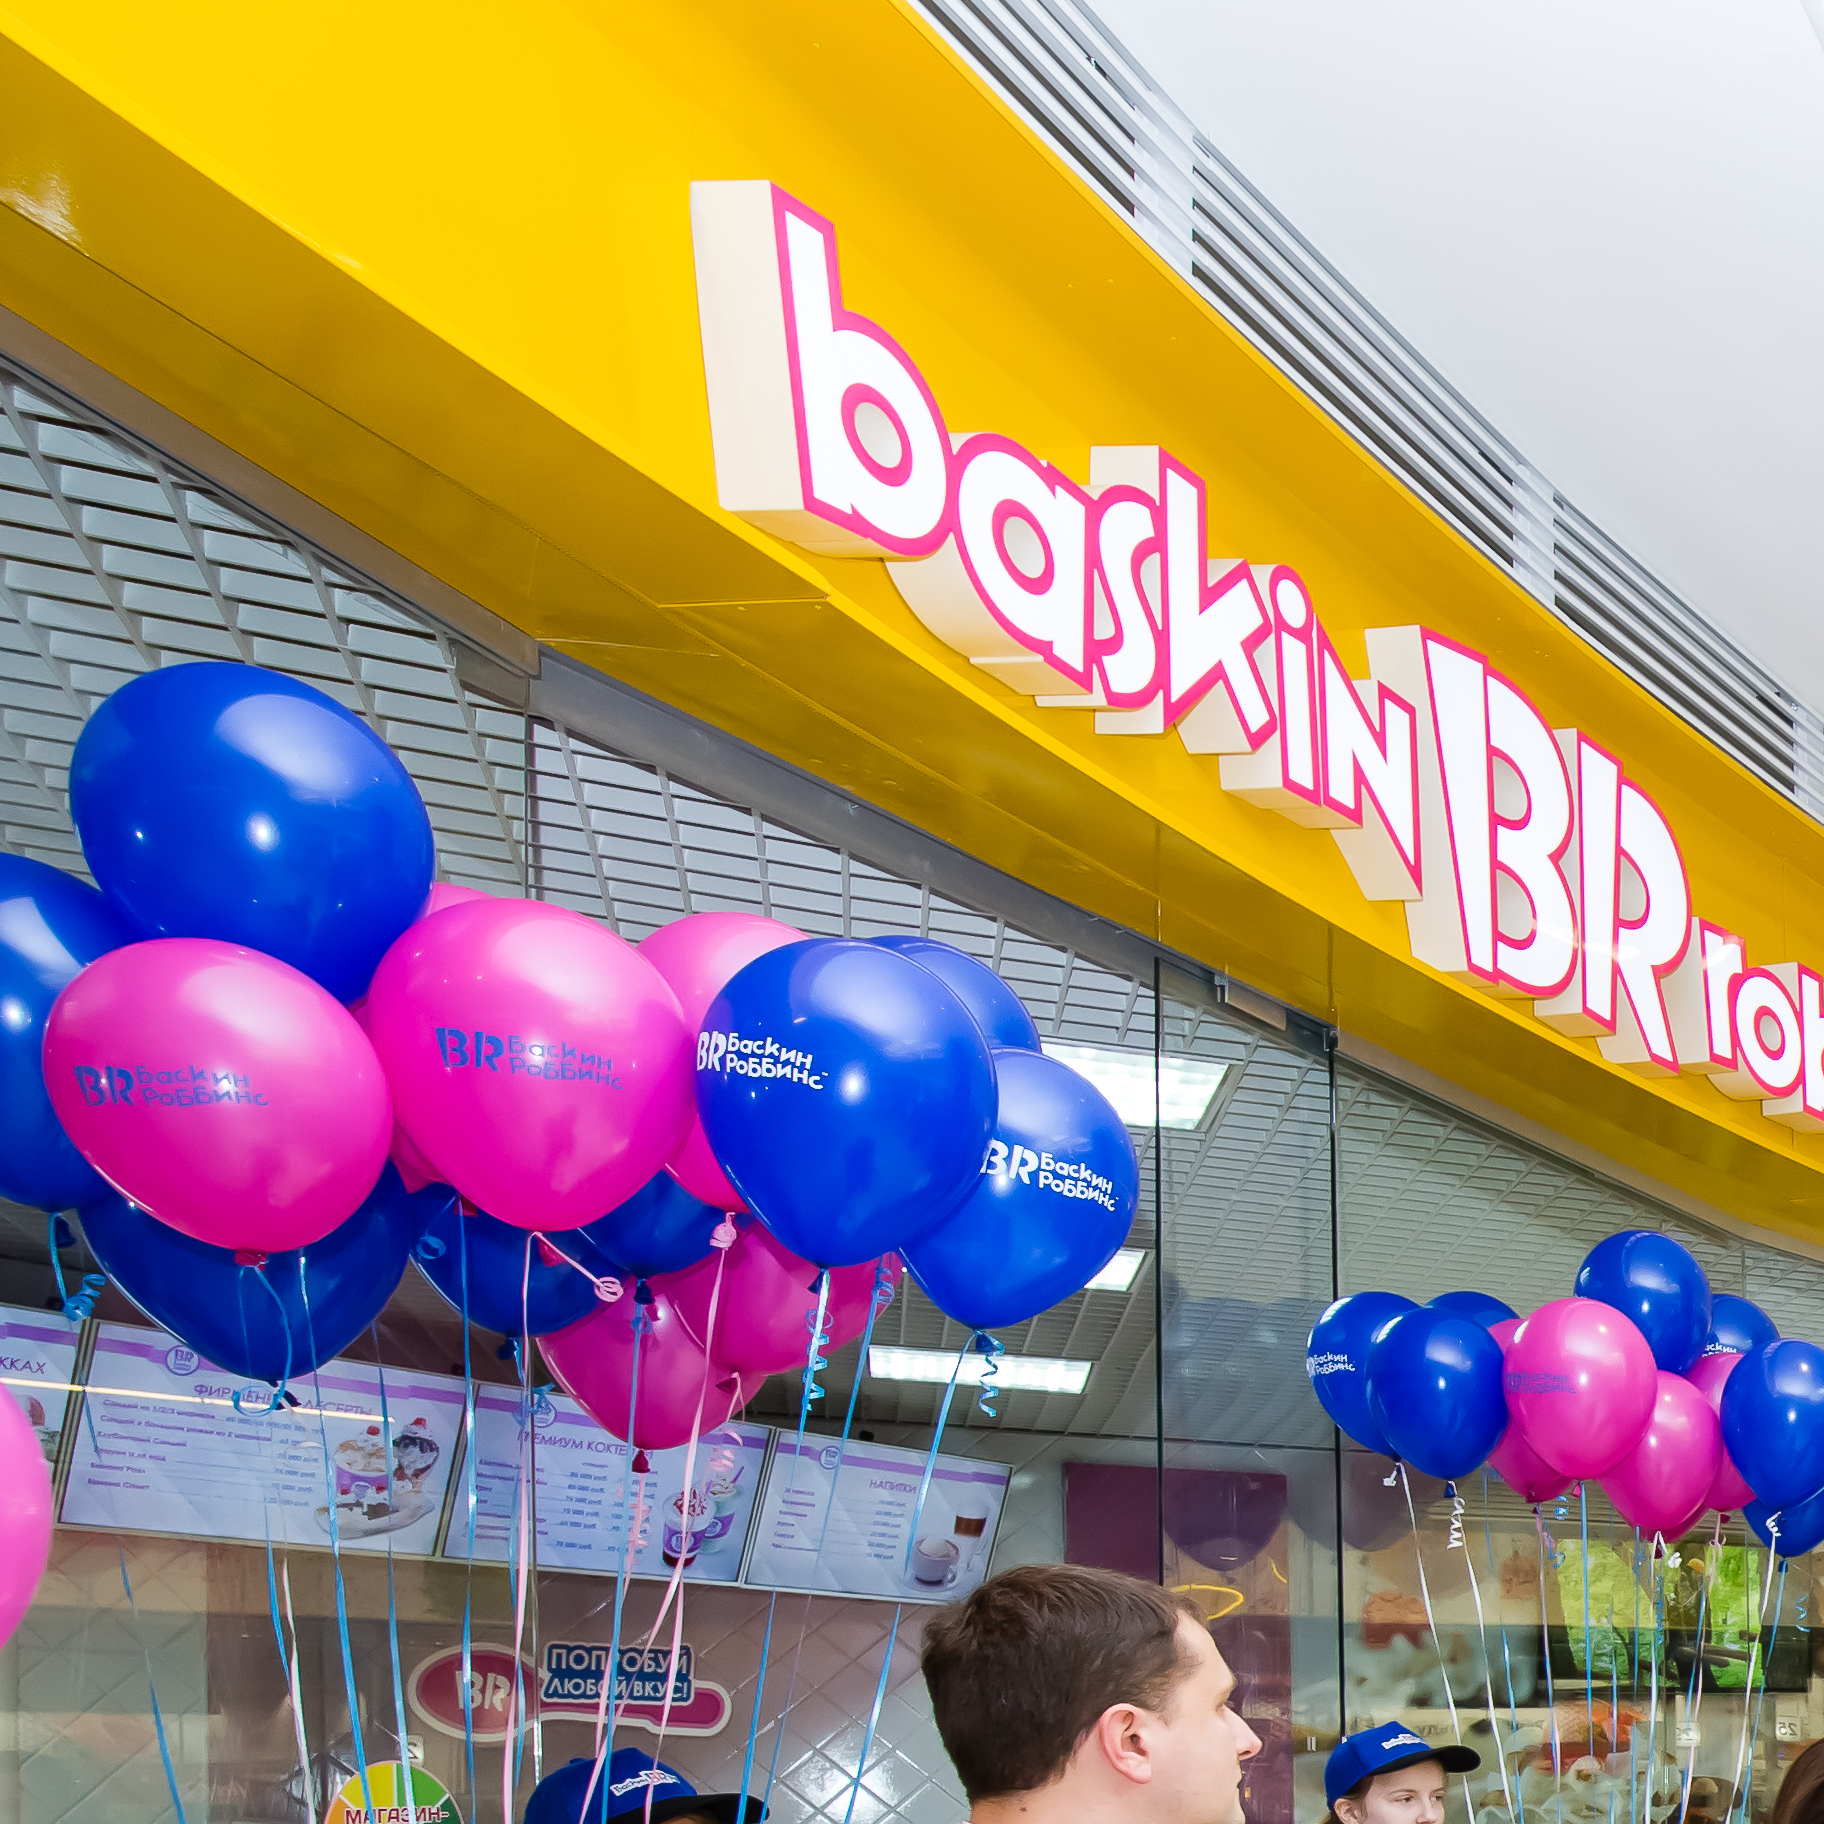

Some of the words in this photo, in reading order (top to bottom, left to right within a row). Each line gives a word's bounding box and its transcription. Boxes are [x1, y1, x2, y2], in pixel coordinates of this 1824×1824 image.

[1408, 622, 1695, 1078] BR
[433, 1026, 506, 1073] BR
[696, 1030, 728, 1073] BR
[73, 1064, 136, 1108] BR
[517, 1430, 583, 1450] ЕМИУМ
[551, 1648, 688, 1675] ПОПОБУЙ
[455, 1670, 511, 1712] BR
[548, 1676, 628, 1696] ЛЮБЙ
